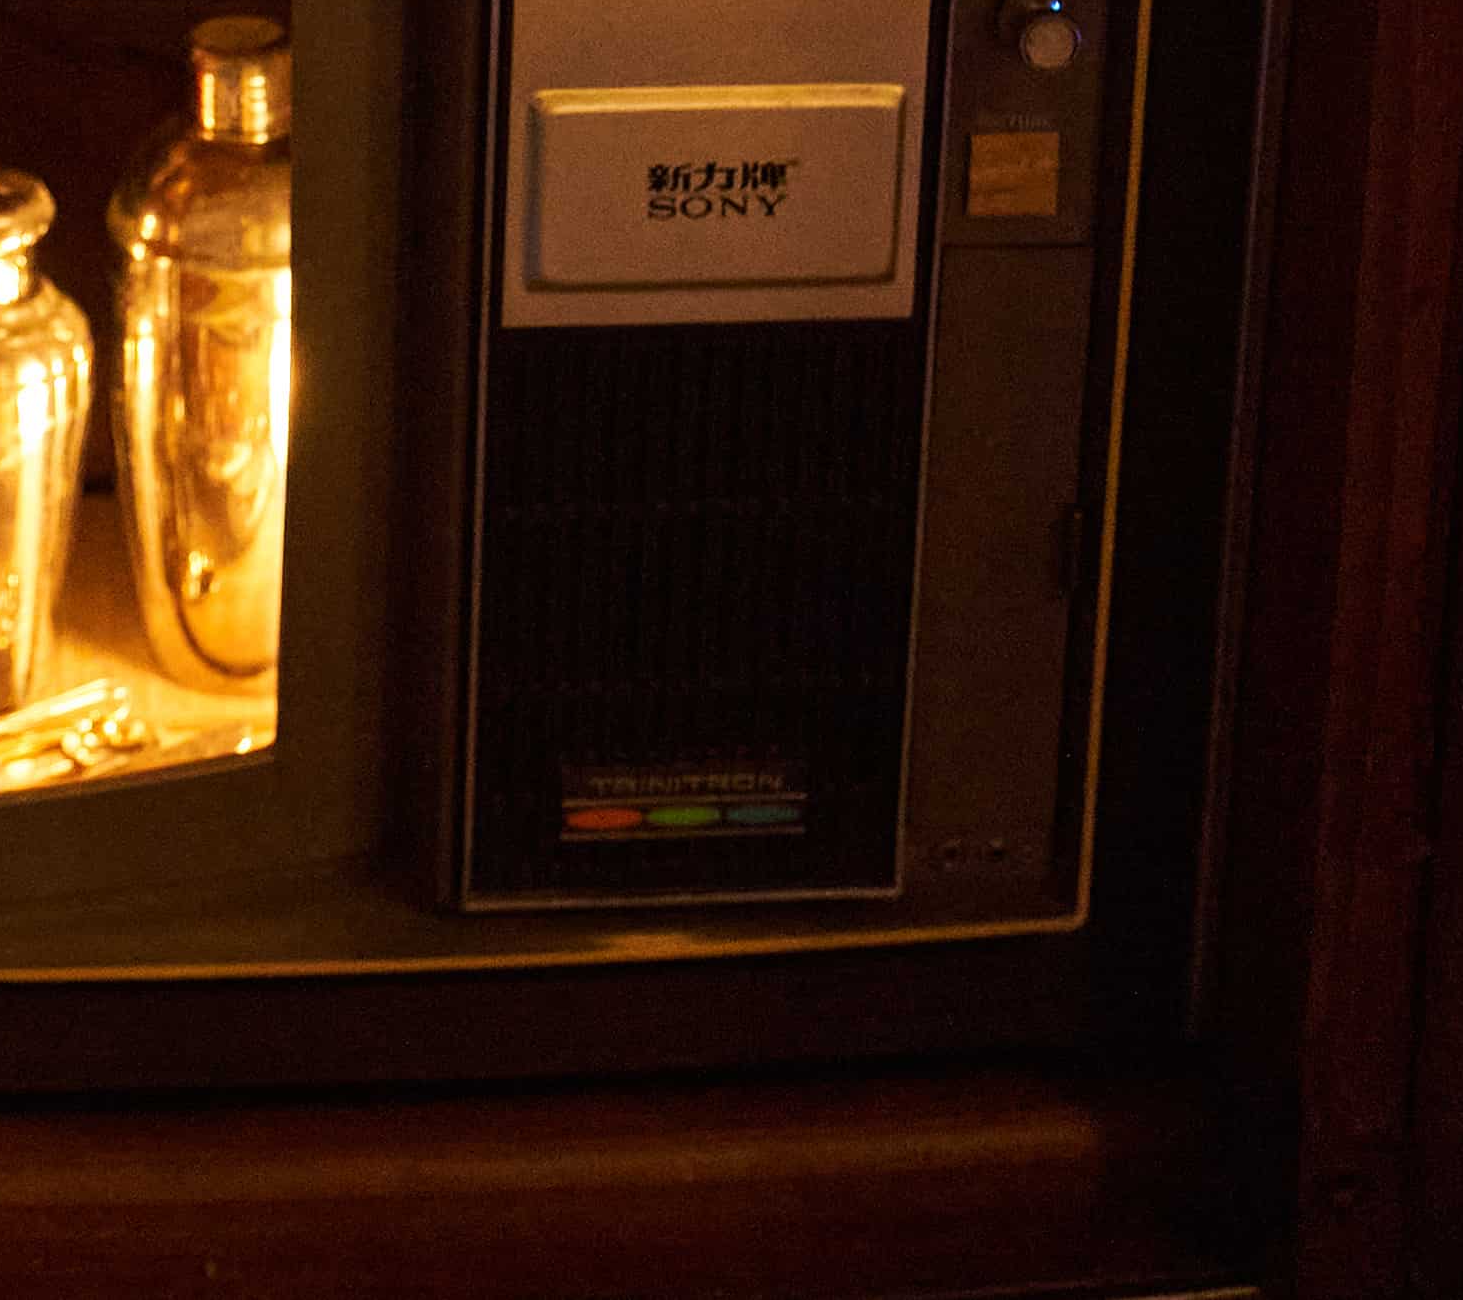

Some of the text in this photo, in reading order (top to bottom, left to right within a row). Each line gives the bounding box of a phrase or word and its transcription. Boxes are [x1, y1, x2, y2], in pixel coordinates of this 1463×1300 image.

[647, 161, 788, 192] 新力牌
[647, 195, 787, 221] SONY
[587, 773, 786, 793] TRINITRON
